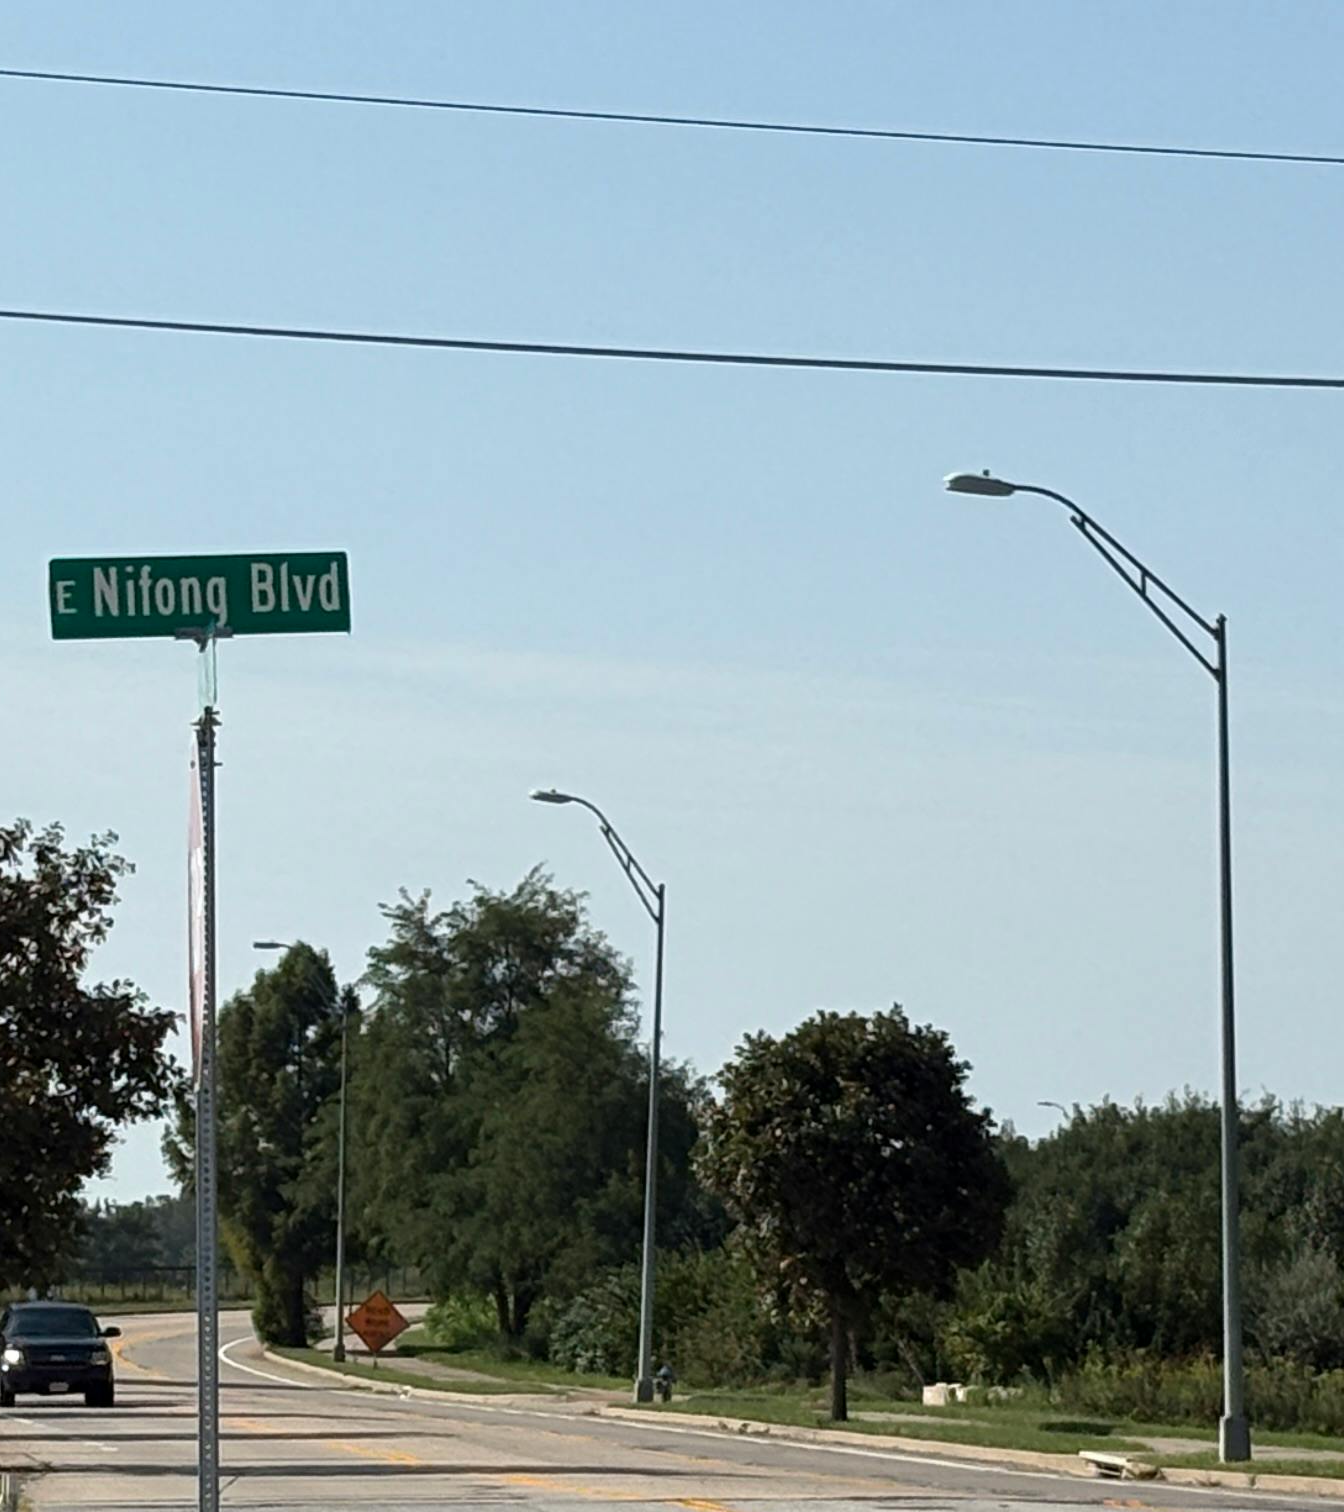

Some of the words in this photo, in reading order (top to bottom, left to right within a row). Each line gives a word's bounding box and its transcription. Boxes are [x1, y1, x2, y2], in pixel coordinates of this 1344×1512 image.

[56, 580, 78, 614] E
[93, 565, 228, 628] Nifong
[250, 561, 341, 613] Blvd
